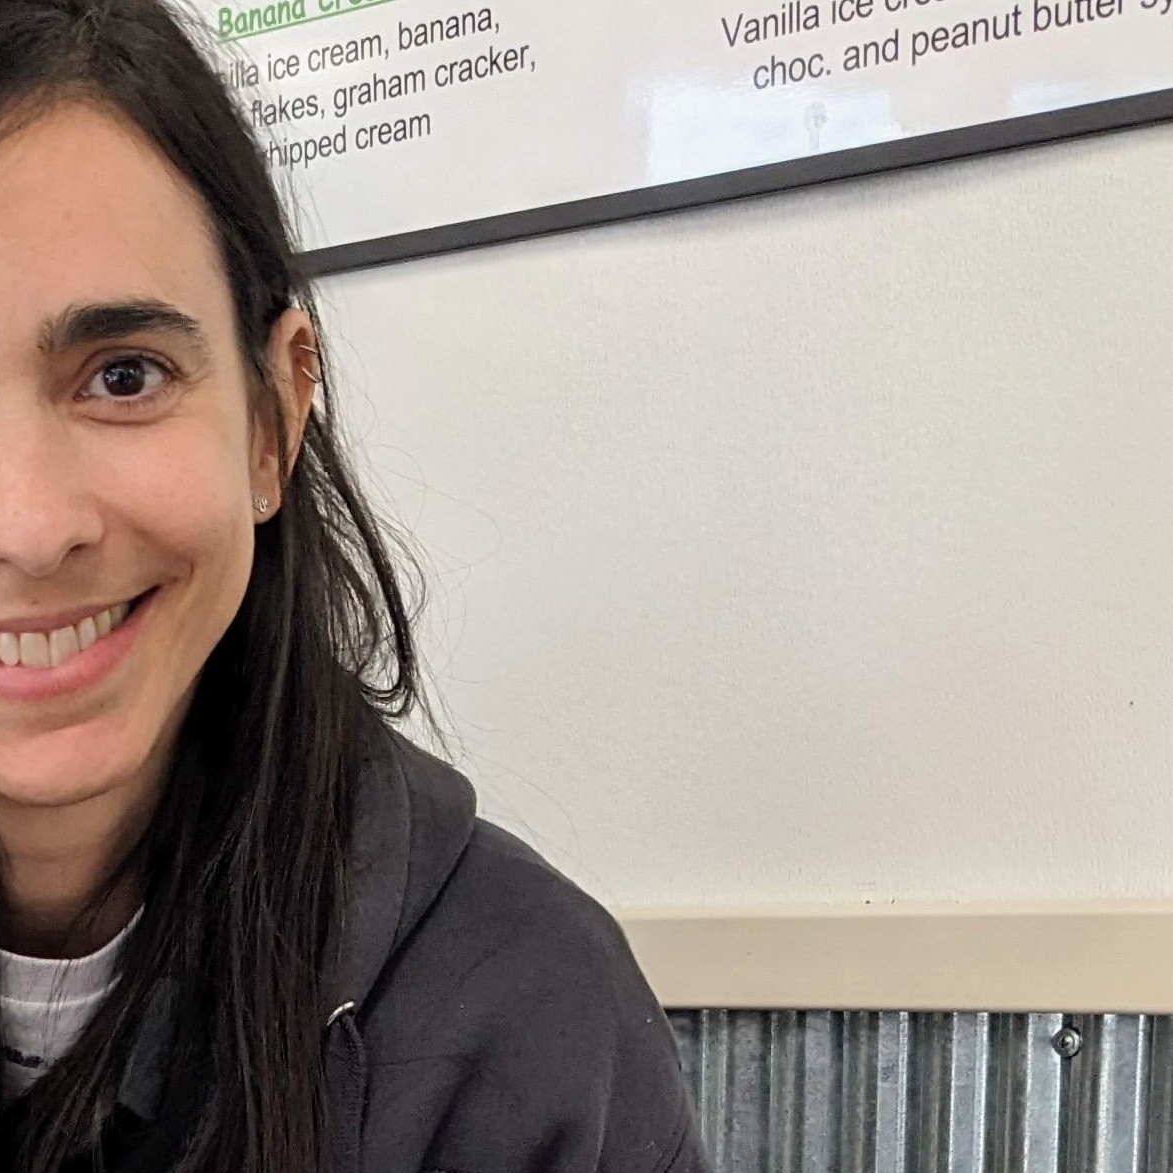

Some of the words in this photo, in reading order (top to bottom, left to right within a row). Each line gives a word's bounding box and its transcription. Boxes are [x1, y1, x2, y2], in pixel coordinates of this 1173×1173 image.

[218, 0, 306, 38] Banana
[268, 53, 300, 82] ice
[308, 34, 389, 72] cream,
[398, 8, 501, 53] banana,
[721, 3, 821, 48] Vanilla
[753, 53, 831, 90] choc.
[843, 29, 900, 72] and
[911, 5, 1022, 65] peanut
[333, 68, 427, 118] graham
[435, 43, 536, 89] cracker,
[262, 124, 347, 172] hipped
[355, 111, 431, 150] cream
